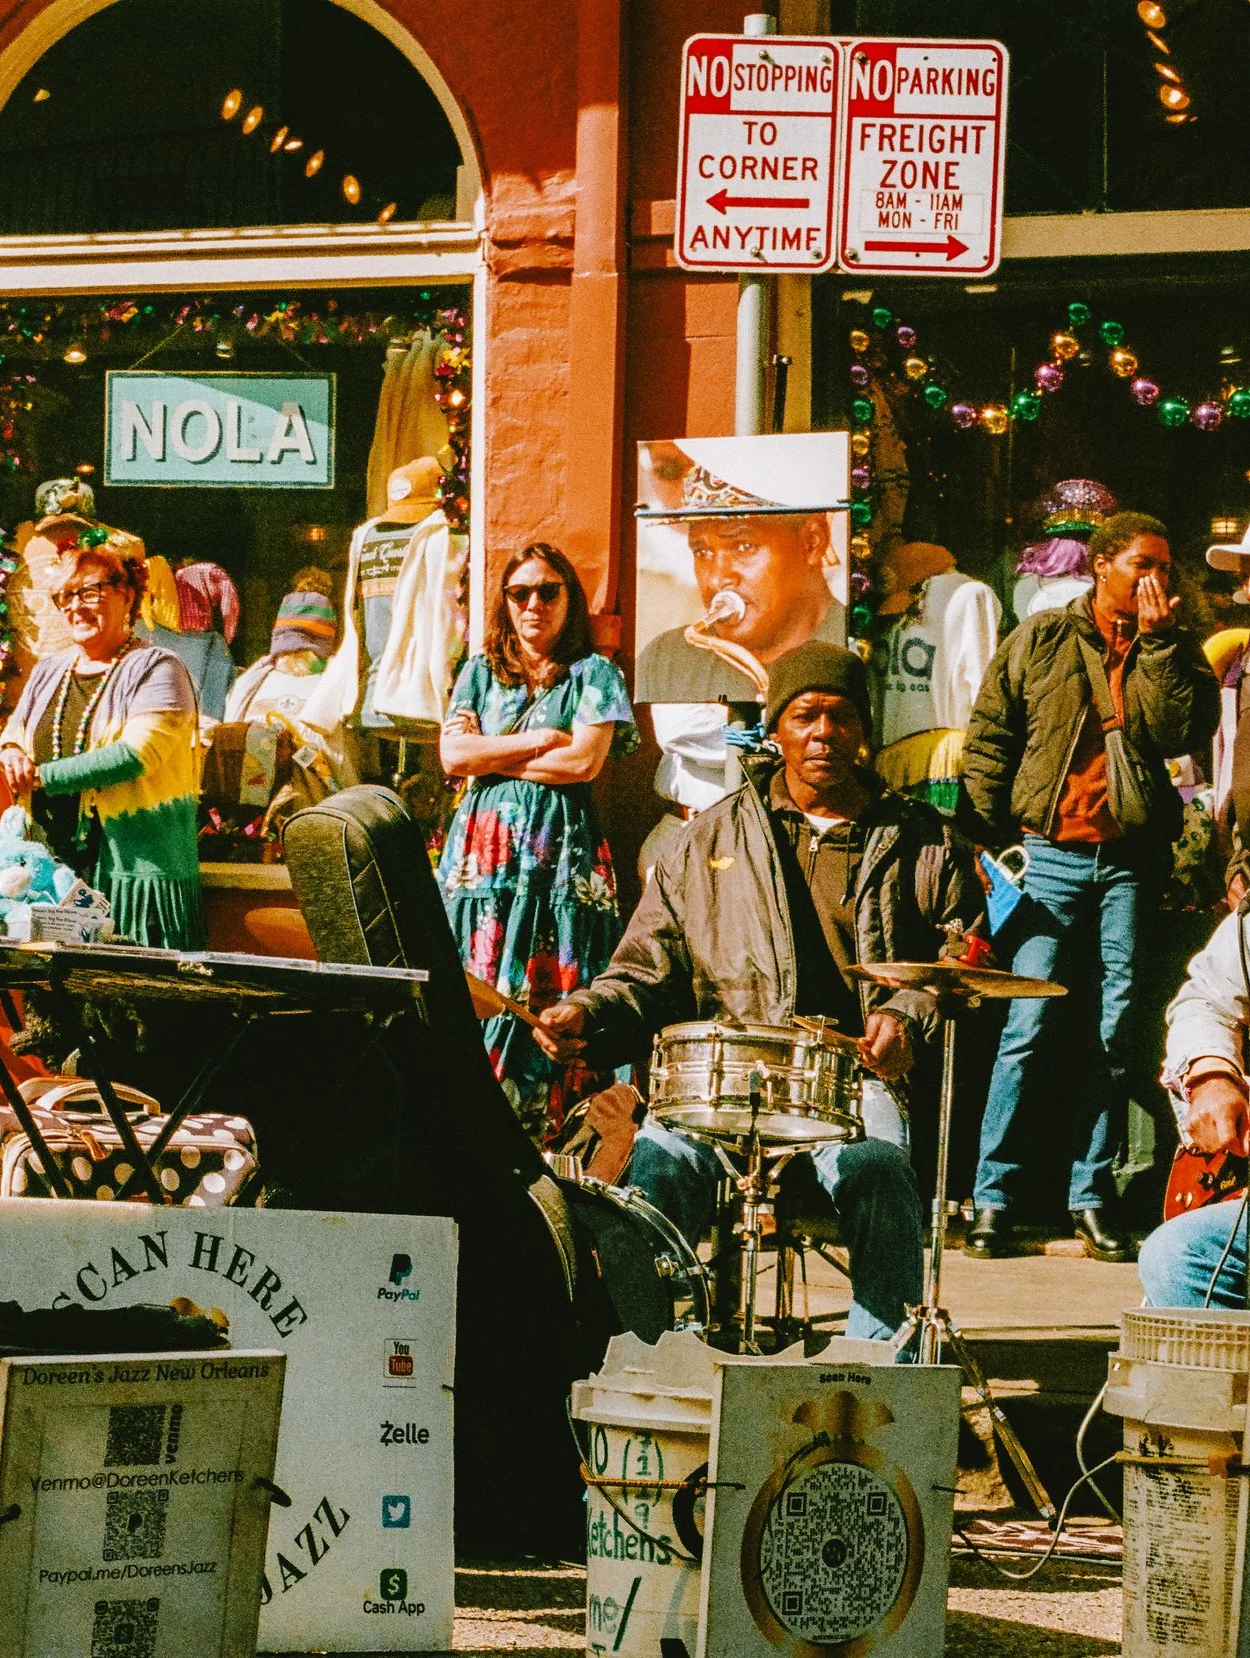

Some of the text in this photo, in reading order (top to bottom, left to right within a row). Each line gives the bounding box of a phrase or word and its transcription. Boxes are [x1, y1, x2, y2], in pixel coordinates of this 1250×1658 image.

[687, 55, 832, 97] NO STOPPING
[850, 59, 996, 101] NO PARKING
[742, 121, 777, 146] TO
[859, 123, 987, 155] FREIGHT
[699, 154, 818, 181] CORNER
[880, 159, 960, 190] ZONE
[875, 191, 907, 208] 8AM
[930, 192, 963, 211] 11AM
[878, 212, 911, 229] MON
[934, 213, 959, 230] FRI
[689, 224, 821, 251] ANYTIME
[120, 400, 317, 465] NOLA
[188, 1231, 308, 1339] HERE
[377, 1287, 420, 1303] PayPal
[393, 1341, 410, 1356] You
[23, 1361, 269, 1386] Doreen's Jazz New Orleans
[391, 1358, 412, 1373] Tube
[164, 1404, 184, 1465] venmo
[380, 1420, 430, 1446] Zelle
[30, 1468, 244, 1492] Venmo@DoreenKetchens
[38, 1560, 218, 1585] Paypal.me/DoreensJazz
[363, 1600, 425, 1616] Cash App
